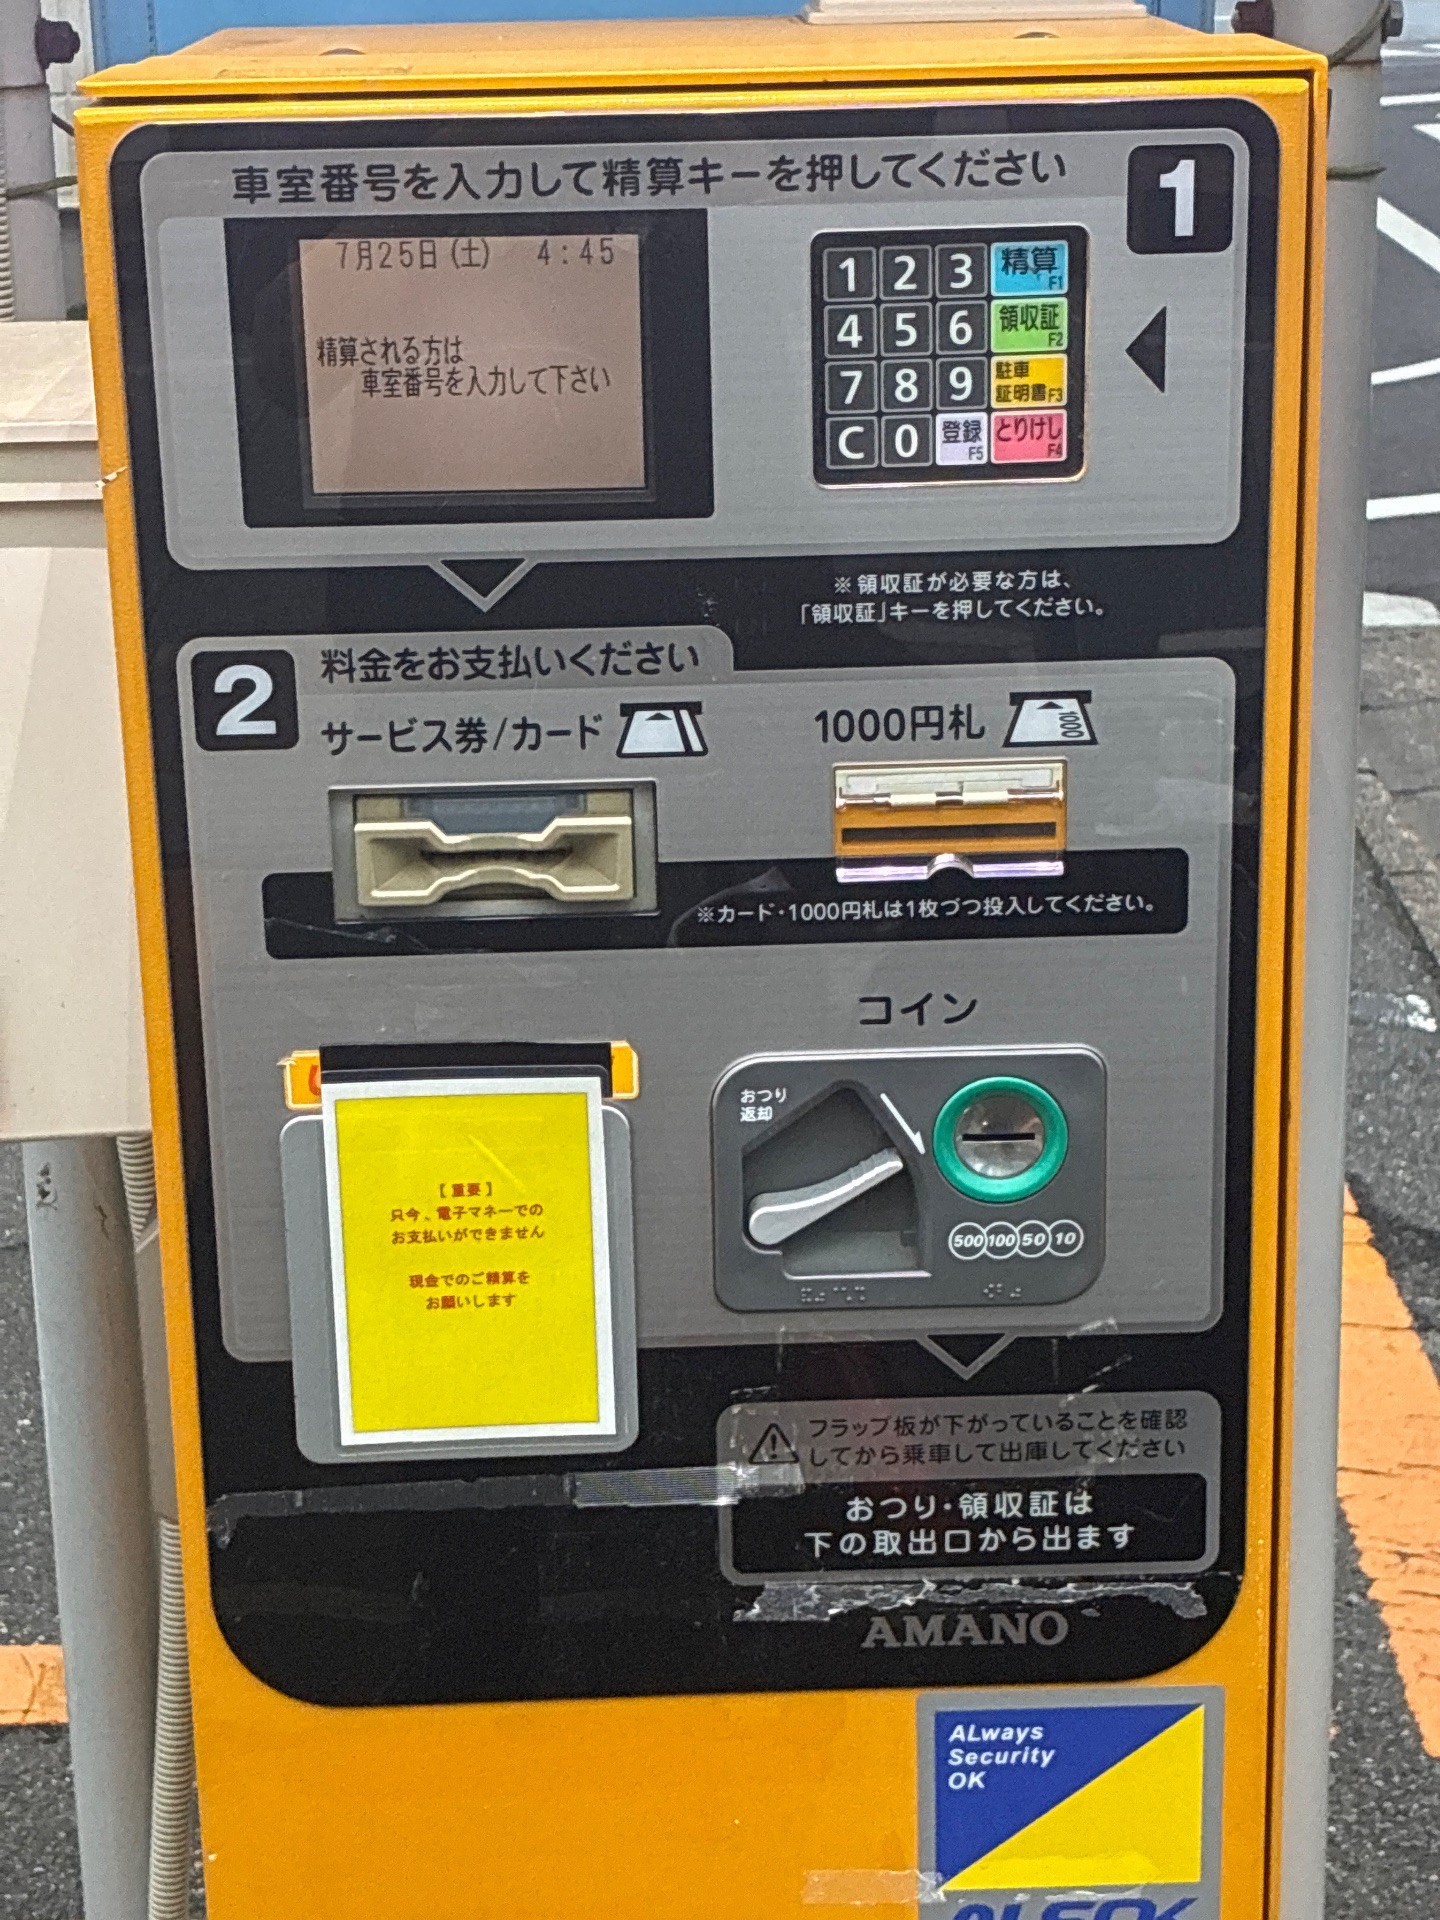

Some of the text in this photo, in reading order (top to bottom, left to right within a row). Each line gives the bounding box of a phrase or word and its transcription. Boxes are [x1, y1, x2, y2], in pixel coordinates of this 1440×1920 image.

[231, 149, 1067, 204] 車室番号を入力して精算キーを押してください
[1160, 159, 1196, 236] 1
[537, 236, 615, 266] 4:45
[1001, 247, 1058, 276] 精算
[839, 253, 973, 292] 1 2 3
[1049, 276, 1063, 290] F1
[837, 310, 973, 349] 4 5 6
[999, 303, 1060, 332] 領収証
[316, 335, 464, 368] 精算される方は
[1048, 332, 1064, 347] F2
[361, 364, 611, 400] 車室番号を入力して下さい
[995, 361, 1030, 379] 駐車
[840, 366, 973, 405] 7 8 9
[995, 384, 1047, 403] 証明書
[1048, 388, 1063, 403] F3
[838, 424, 919, 460] C 0
[942, 420, 982, 444] 登録
[995, 415, 1063, 442] とりけし
[968, 446, 984, 461] F5
[800, 597, 1105, 626] 「領収証」キーを押してください。
[320, 640, 701, 684] 料金をお支払いください
[214, 663, 277, 737] 2
[320, 714, 603, 757] サービス券/カード
[813, 702, 986, 744] 1000円札
[1058, 710, 1085, 739] 1000
[858, 992, 978, 1027] コイン
[740, 1087, 788, 1104] おつり
[740, 1106, 774, 1123] 返却
[439, 1181, 492, 1199] 【重要】
[390, 1203, 544, 1222] 只今、電子マネーでの
[391, 1225, 545, 1245] お支払いができません
[954, 1231, 1077, 1248] 500 100 50 10
[408, 1270, 530, 1289] 現金でのご精算を
[426, 1293, 516, 1310] お願いします
[809, 1408, 1188, 1439] フラップ板が下がっていることを確認
[810, 1438, 1185, 1467] してから乗車して出庫してください
[804, 1523, 1135, 1558] 下の取出口から出ます
[860, 1611, 1069, 1649] AMANO
[948, 1724, 1044, 1744] ALways
[947, 1747, 1055, 1767] Security
[947, 1771, 986, 1790] OK
